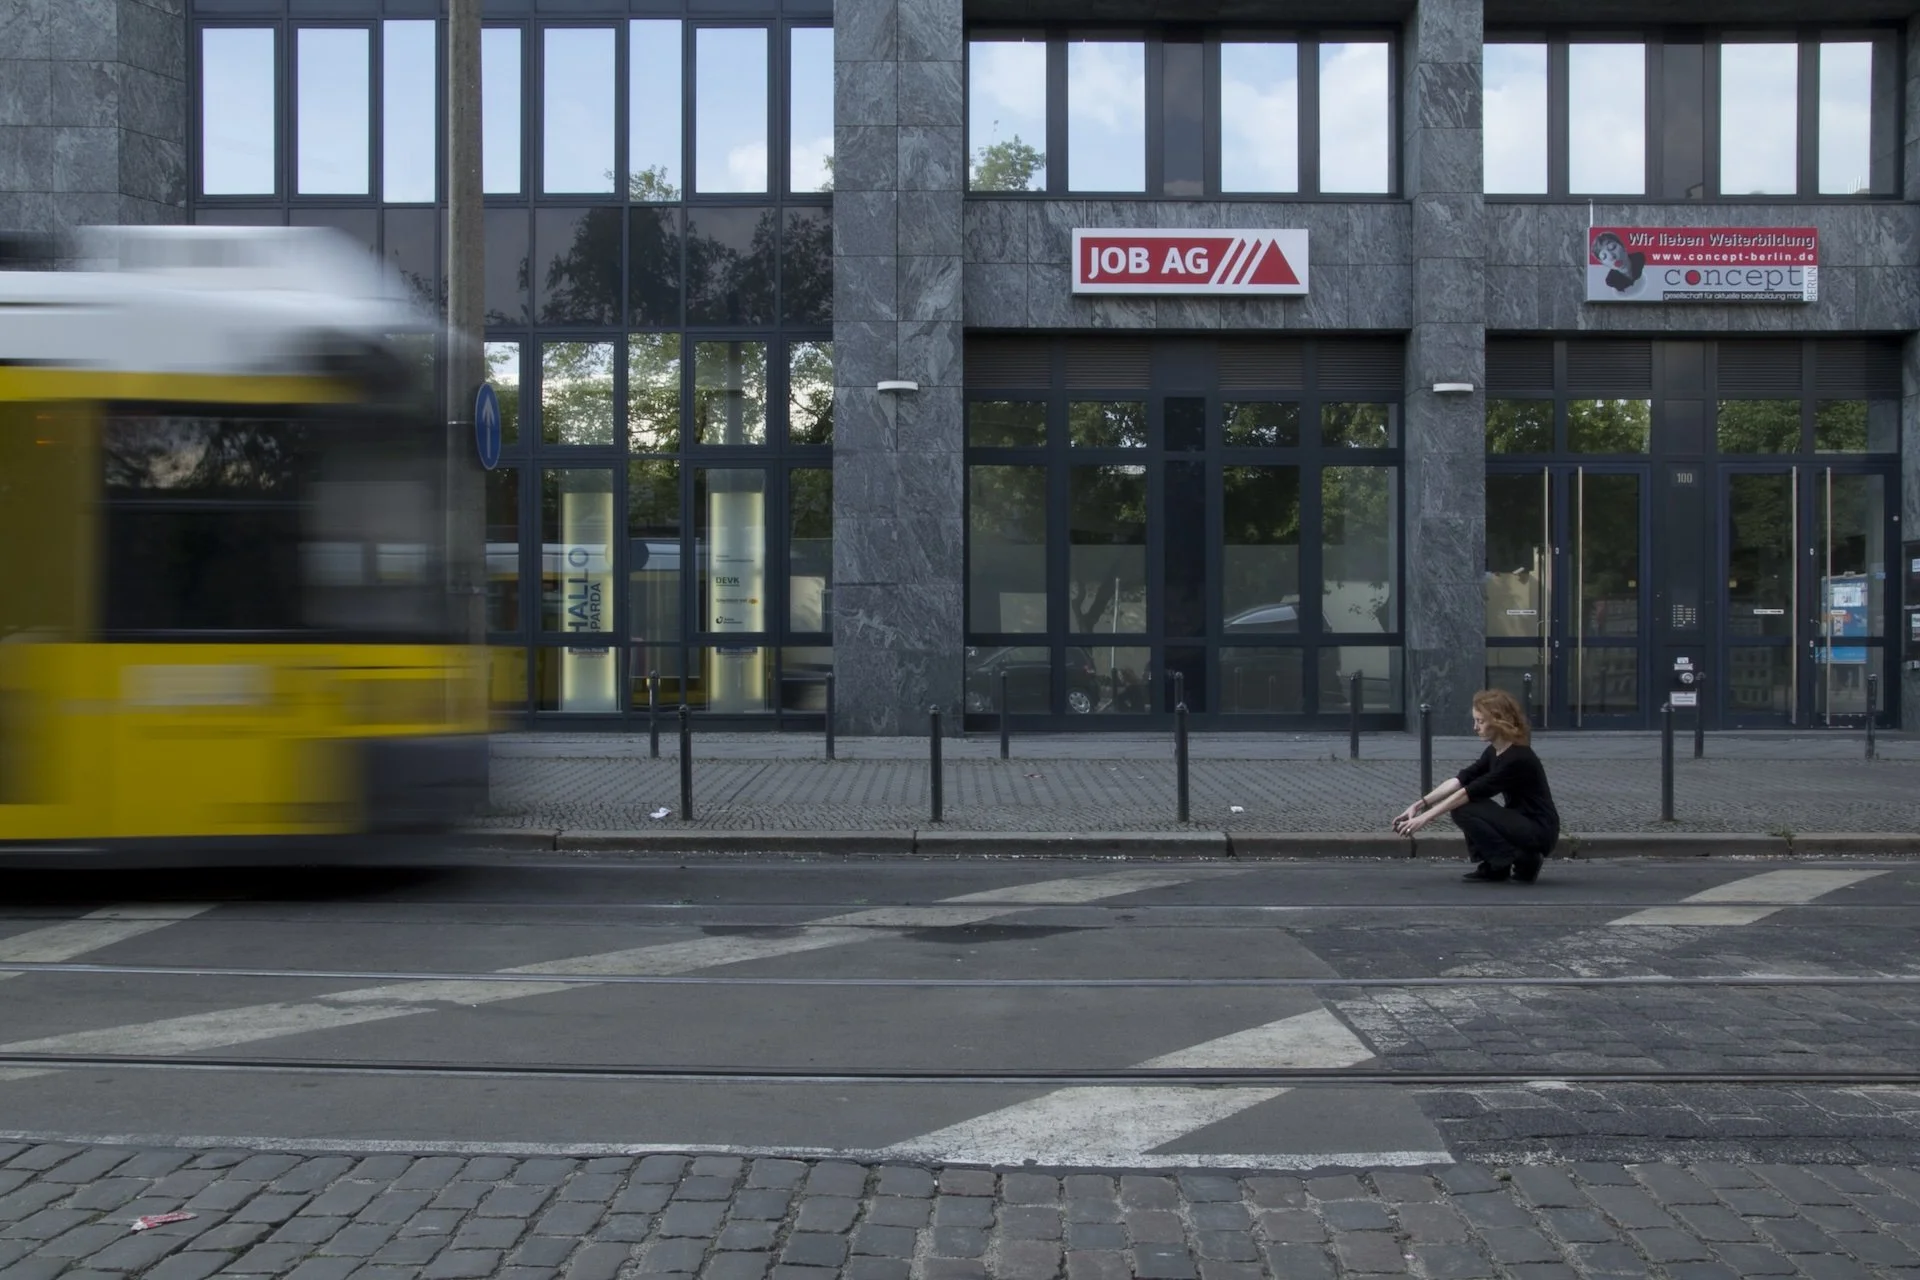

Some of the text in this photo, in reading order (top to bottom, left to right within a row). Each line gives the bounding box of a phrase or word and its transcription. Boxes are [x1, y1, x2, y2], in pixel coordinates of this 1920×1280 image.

[1629, 232, 1815, 250] Wir lieben Weiterbildung
[1088, 246, 1209, 280] JOB AG
[1652, 252, 1815, 263] www.concept-berlin.de
[1664, 265, 1803, 291] concept
[1806, 266, 1817, 301] BERLIN
[1676, 472, 1693, 484] 100
[716, 576, 740, 584] DEVK
[590, 582, 601, 632] PARDA
